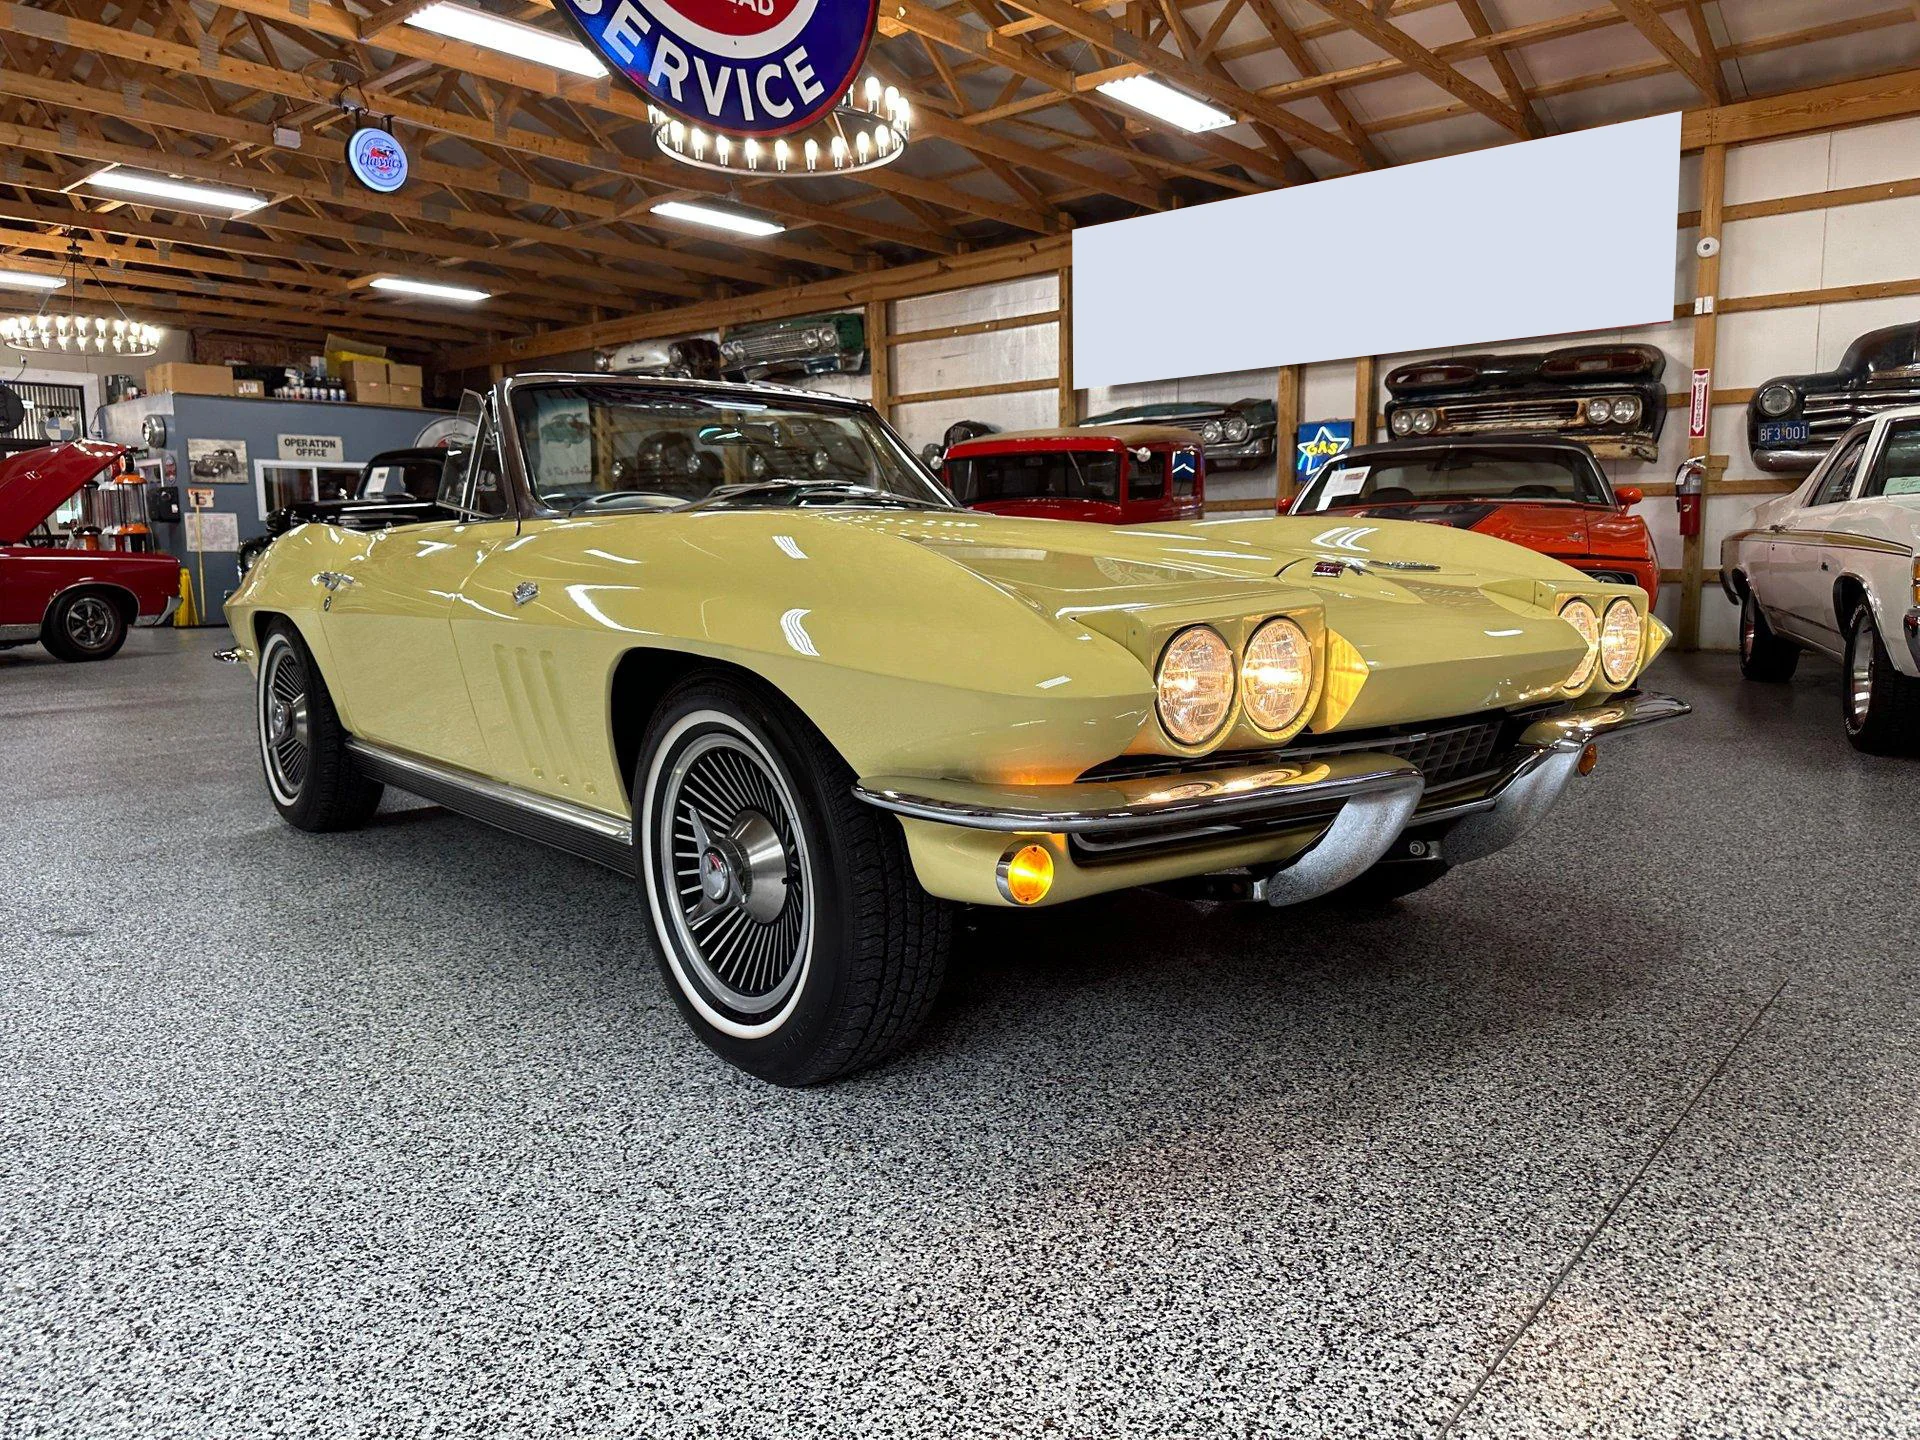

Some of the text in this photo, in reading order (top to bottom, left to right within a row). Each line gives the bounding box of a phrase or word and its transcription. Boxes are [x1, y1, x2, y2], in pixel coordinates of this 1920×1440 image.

[1786, 426, 1806, 440] 001
[284, 438, 336, 448] OPERATION
[1306, 440, 1338, 456] GAS
[296, 448, 327, 457] OFFICE
